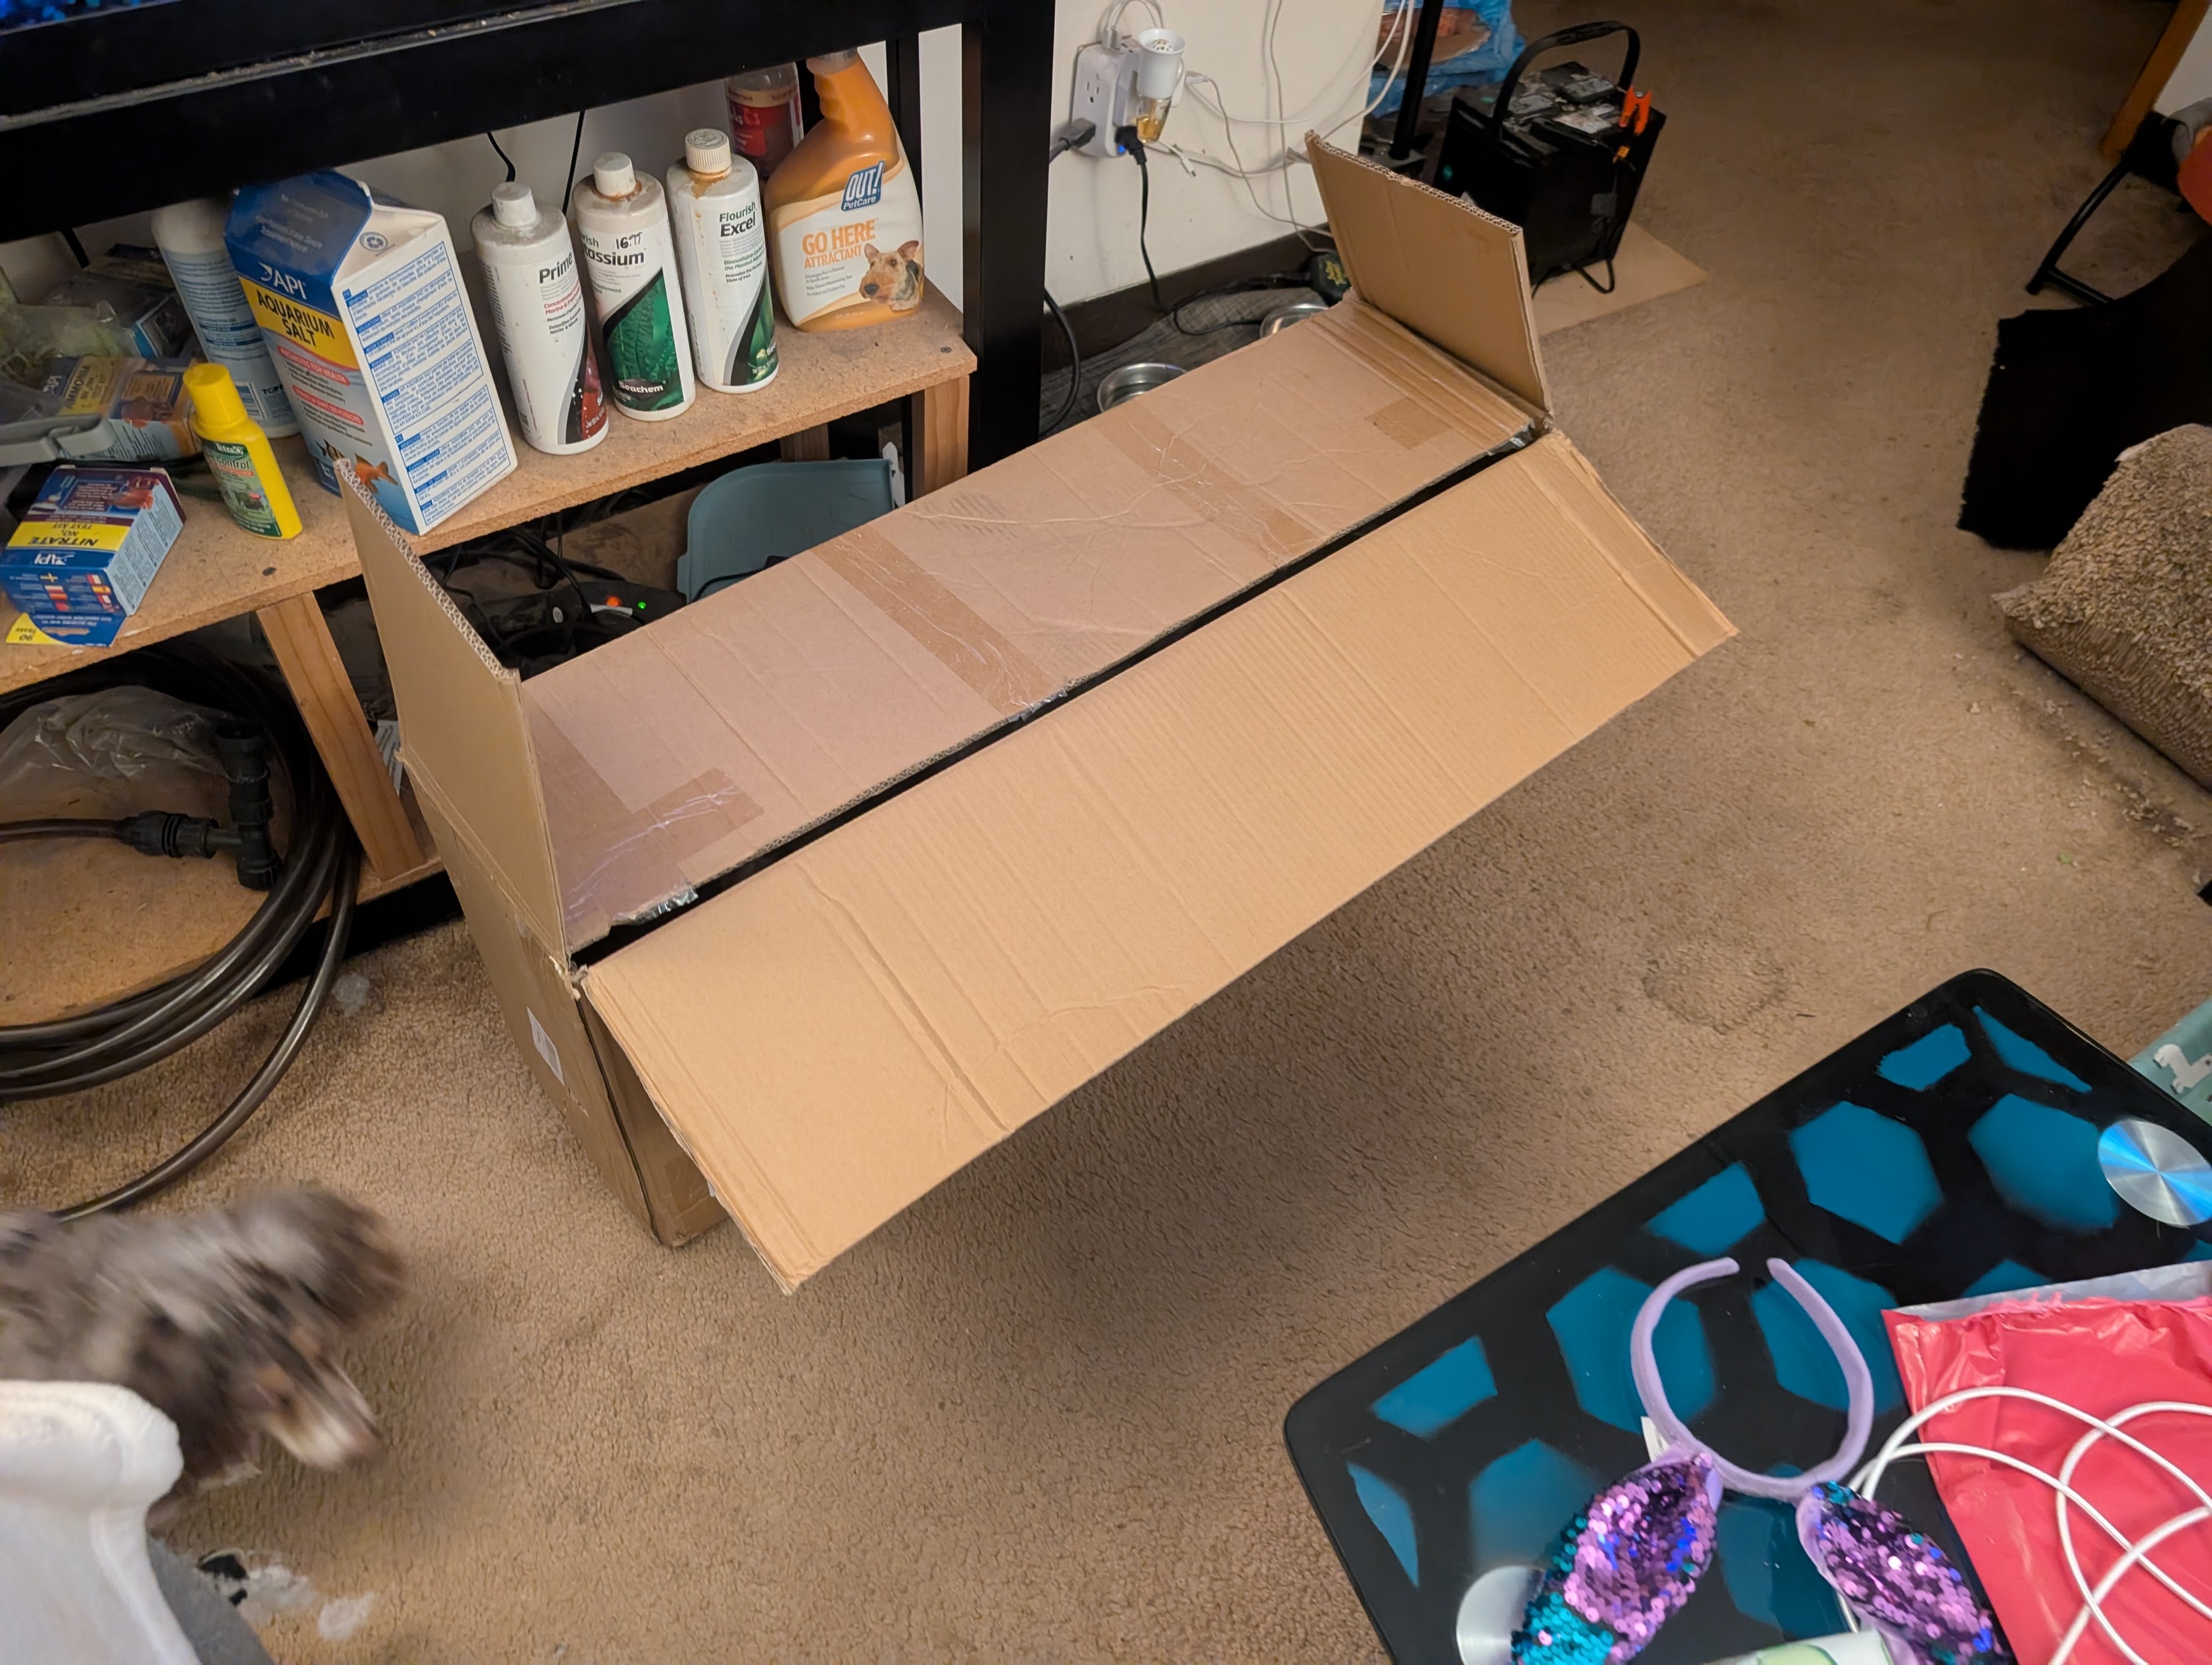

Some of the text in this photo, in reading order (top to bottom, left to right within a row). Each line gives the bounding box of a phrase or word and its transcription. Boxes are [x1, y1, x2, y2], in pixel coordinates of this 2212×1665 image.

[845, 162, 883, 201] OUT!
[719, 201, 756, 223] Flourish
[844, 196, 876, 210] PetCare
[720, 211, 756, 237] Excel
[802, 219, 876, 255] GO HERE
[539, 252, 573, 284] Prime
[805, 244, 862, 269] ATTRACTANT
[272, 269, 307, 300] API
[256, 289, 335, 338] AQUARIUM
[283, 318, 317, 347] SALT
[618, 380, 664, 394] Seachem
[28, 536, 99, 546] NITRATE
[34, 553, 60, 565] API
